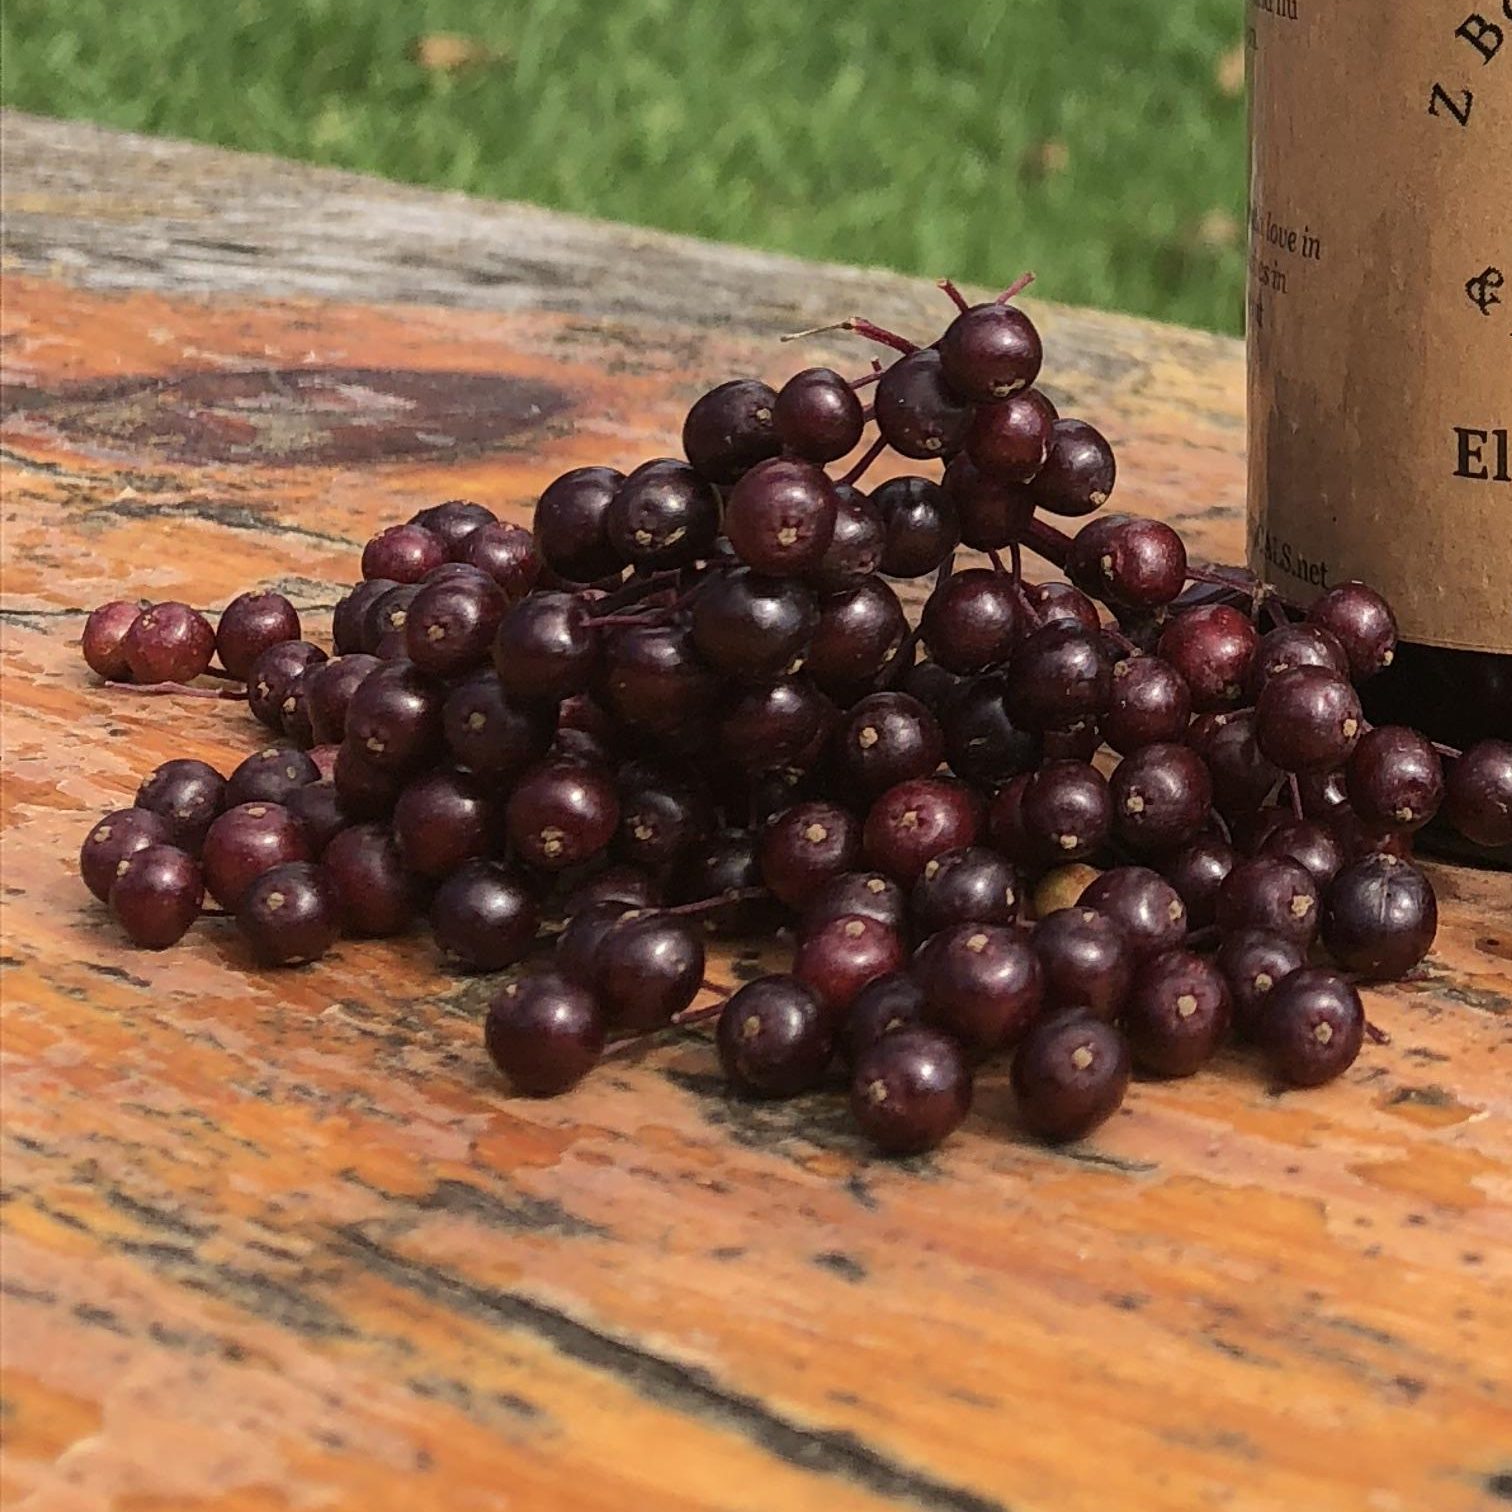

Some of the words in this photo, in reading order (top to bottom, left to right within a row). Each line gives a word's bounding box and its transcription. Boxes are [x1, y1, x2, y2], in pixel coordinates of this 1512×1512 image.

[1428, 82, 1475, 128] Z
[1266, 211, 1298, 254] love
[1301, 224, 1321, 261] in
[1464, 265, 1505, 317] &
